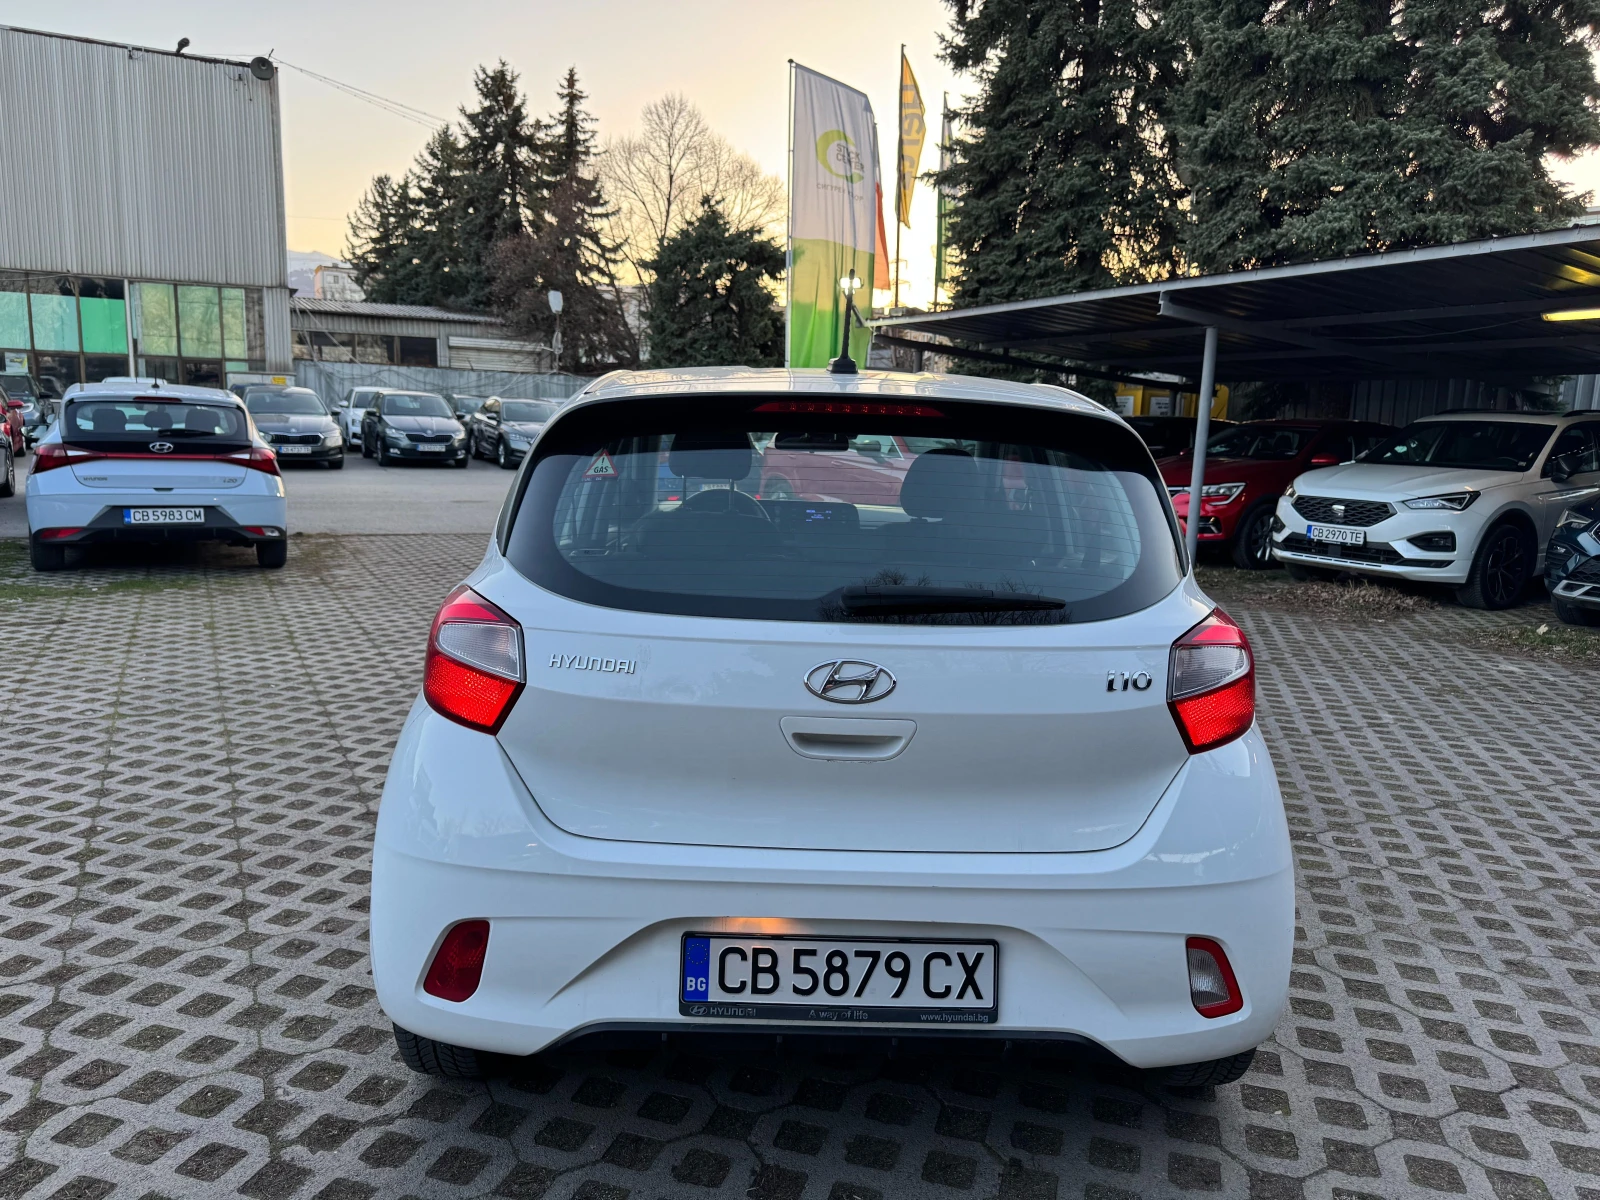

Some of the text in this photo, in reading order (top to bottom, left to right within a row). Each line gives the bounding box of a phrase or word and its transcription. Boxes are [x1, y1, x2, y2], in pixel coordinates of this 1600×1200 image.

[836, 143, 861, 160] STCK
[836, 152, 865, 172] CEER
[133, 510, 149, 521] CB
[152, 510, 183, 521] 5983
[185, 509, 202, 521] CM
[1312, 528, 1324, 538] CB
[1325, 529, 1347, 541] 2970
[1349, 531, 1362, 543] TE
[548, 653, 637, 674] HYUNDAI
[1106, 669, 1152, 692] i10
[717, 946, 985, 1000] CB 5879 CX
[686, 977, 707, 992] BG
[710, 1006, 756, 1017] HYUNDAI
[808, 1009, 868, 1021] A way of life
[920, 1012, 989, 1023] www.hyundai.bg
